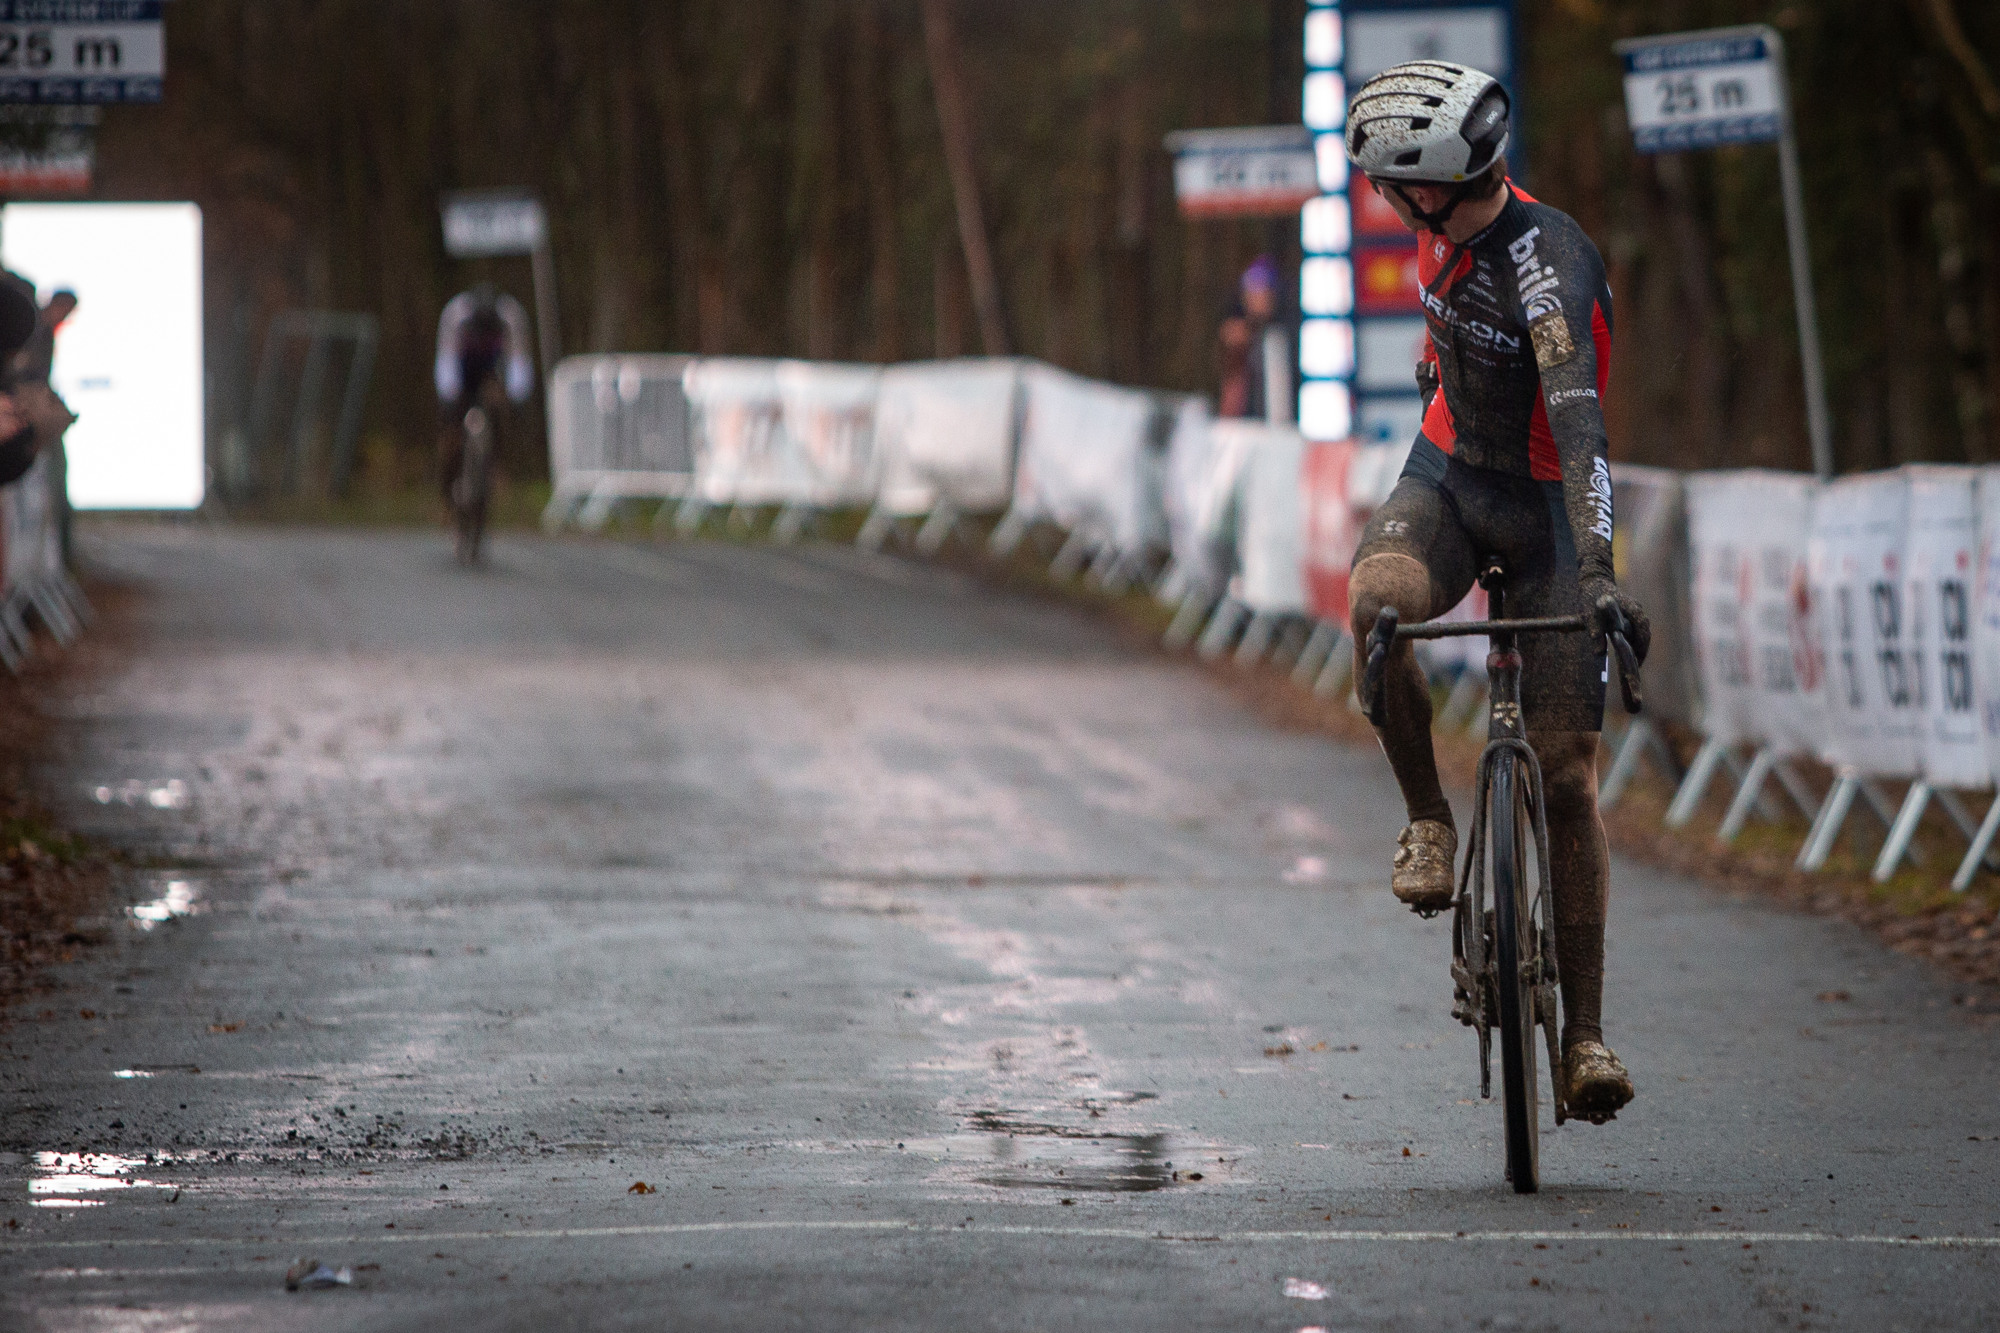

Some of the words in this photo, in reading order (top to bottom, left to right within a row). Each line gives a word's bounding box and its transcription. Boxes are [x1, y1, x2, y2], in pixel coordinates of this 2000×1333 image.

[0, 33, 52, 68] 25
[74, 37, 120, 67] m
[1656, 77, 1698, 117] 25
[1712, 78, 1746, 108] m
[1508, 226, 1563, 322] brilo
[1586, 456, 1613, 542] brilon
